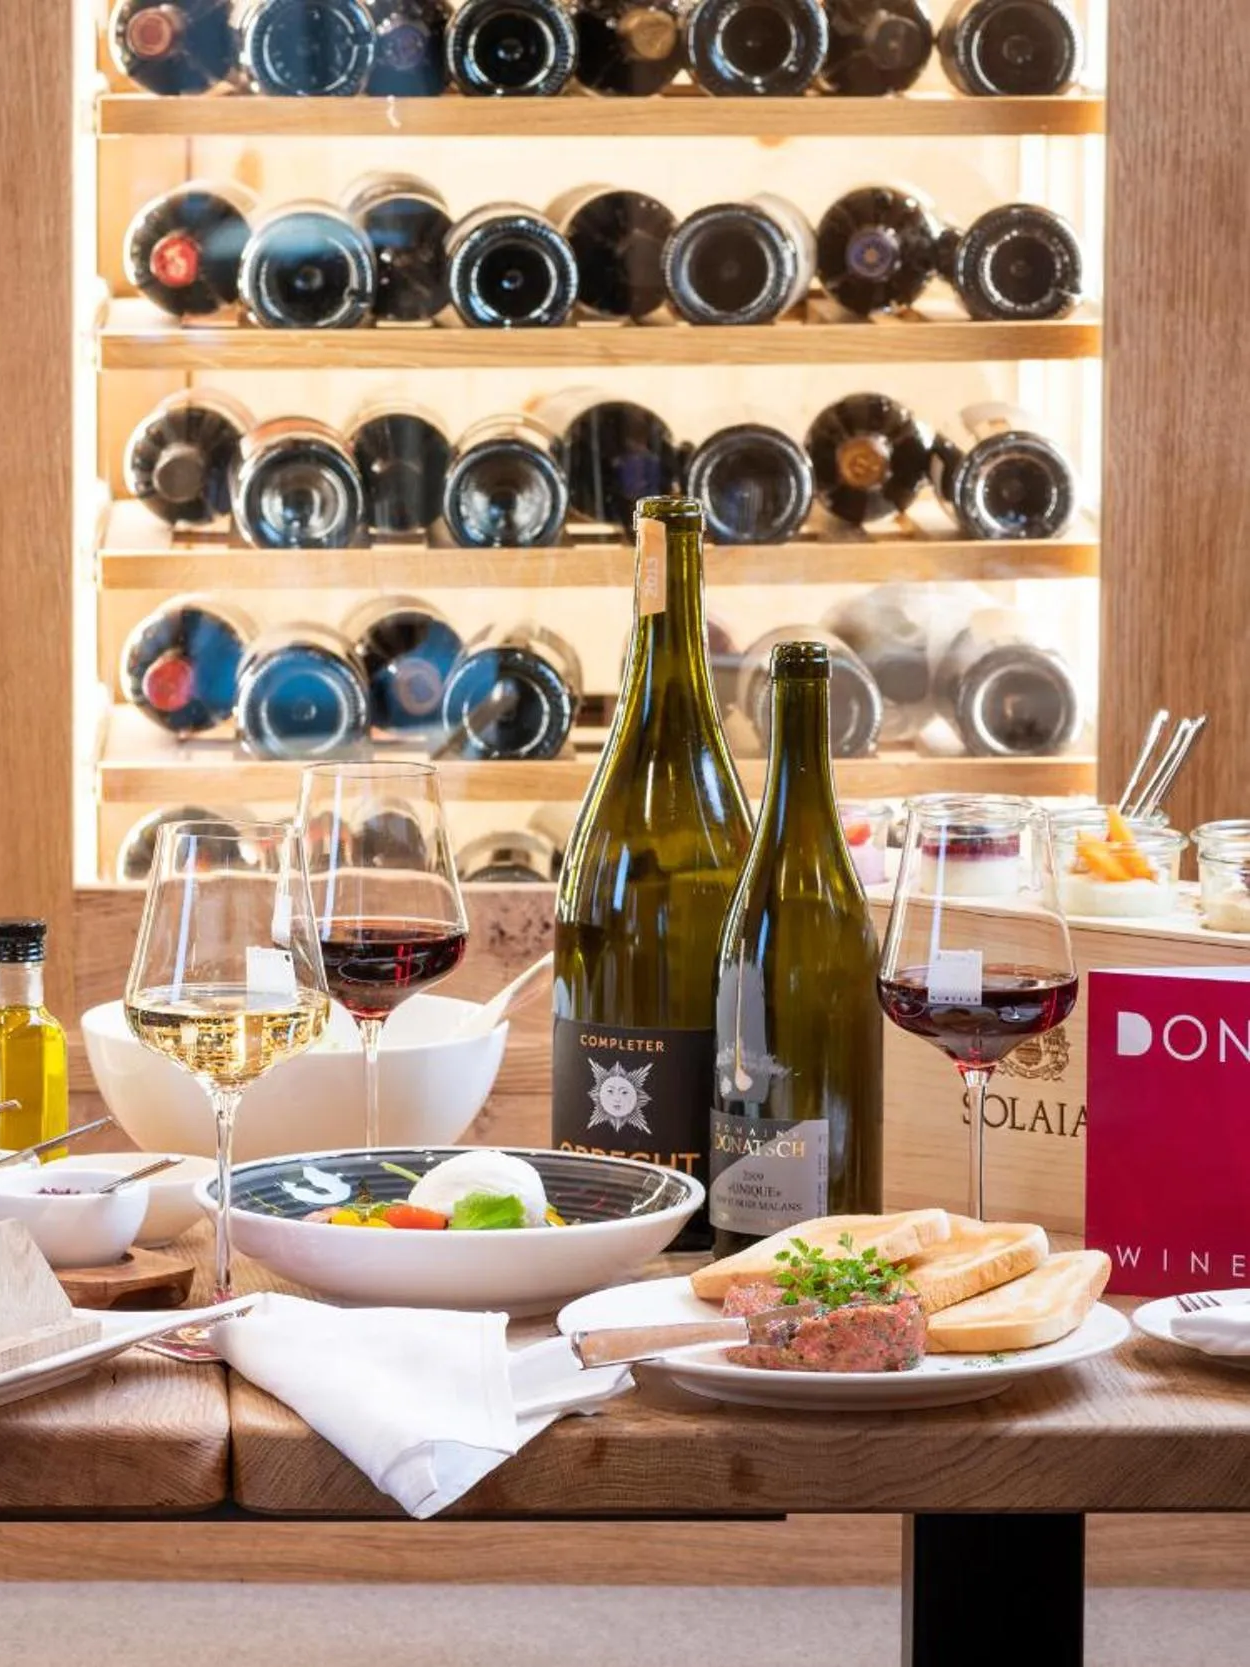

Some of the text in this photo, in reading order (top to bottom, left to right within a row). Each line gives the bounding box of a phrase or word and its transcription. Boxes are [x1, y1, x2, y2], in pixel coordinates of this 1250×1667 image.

[580, 1034, 664, 1052] COMPLETER
[714, 1133, 806, 1158] DONATSCH
[1116, 1245, 1246, 1278] WINE
